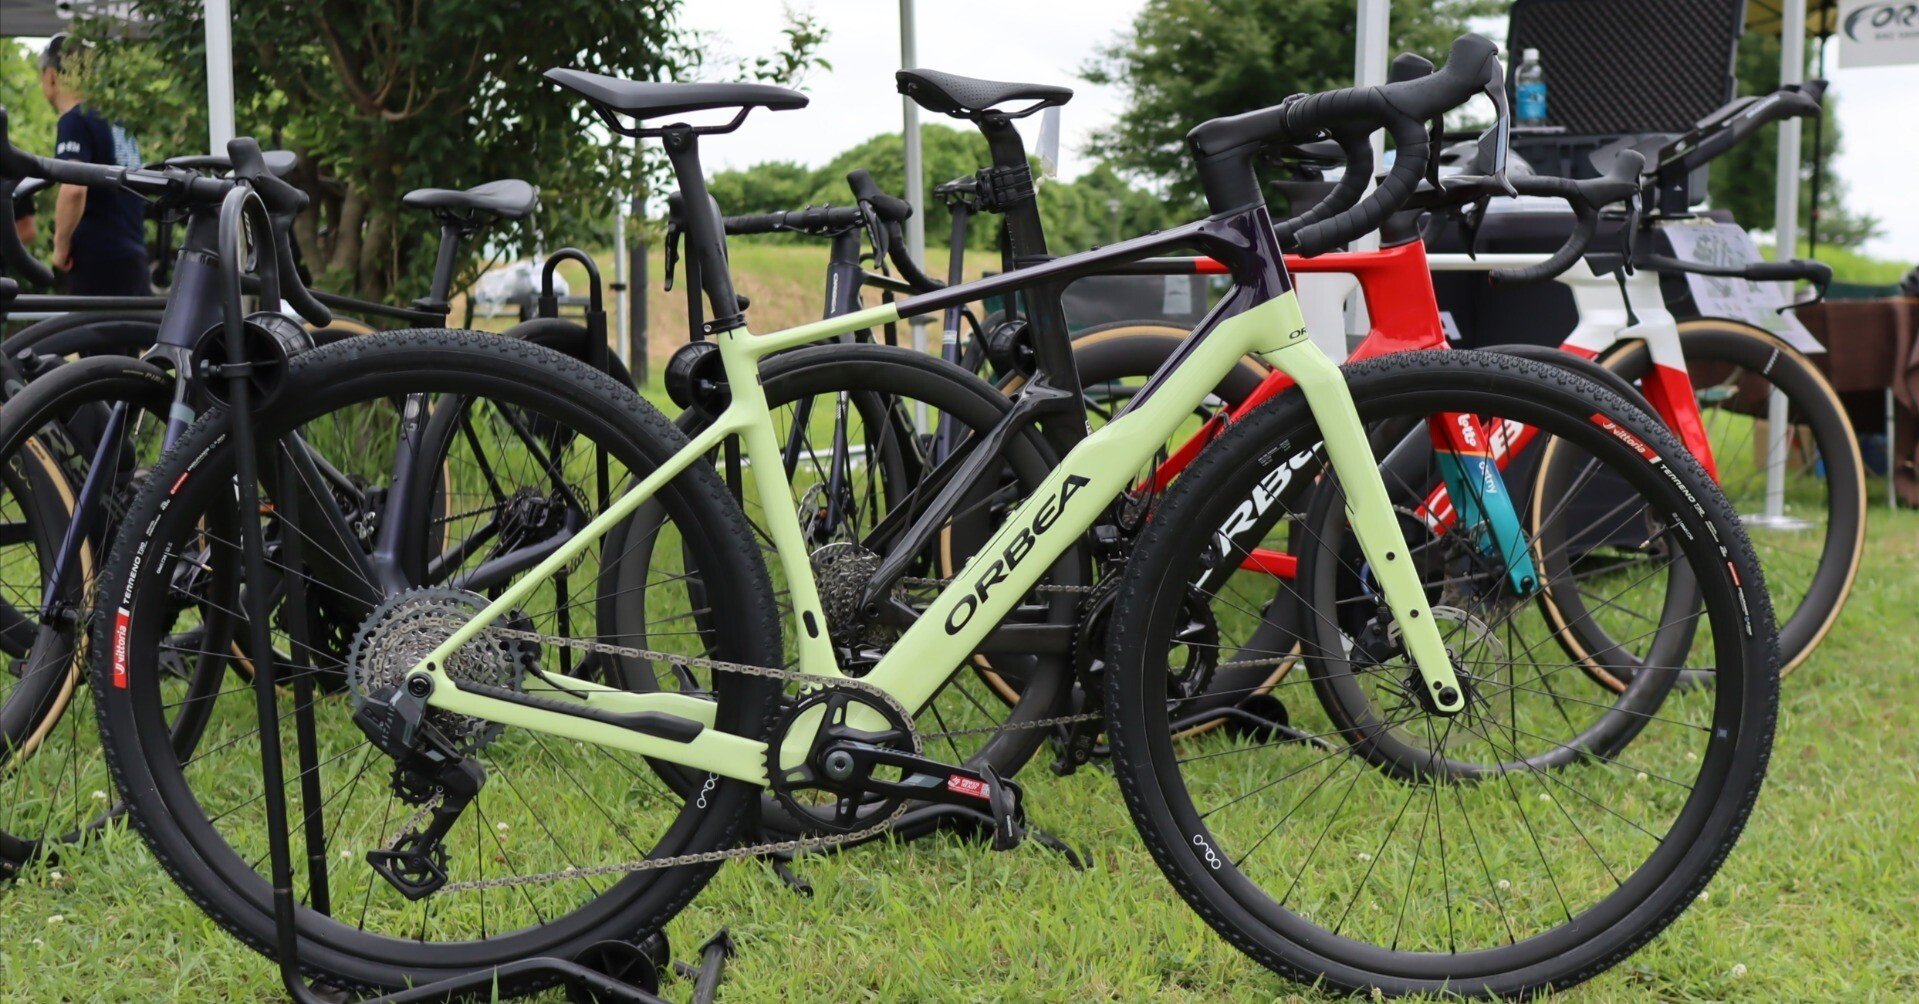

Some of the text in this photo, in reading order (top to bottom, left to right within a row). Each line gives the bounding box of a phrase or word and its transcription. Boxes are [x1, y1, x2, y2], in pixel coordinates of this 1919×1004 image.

[1660, 463, 1697, 503] TERRENO
[123, 555, 142, 606] TERRENO
[944, 474, 1092, 636] ORBEA
